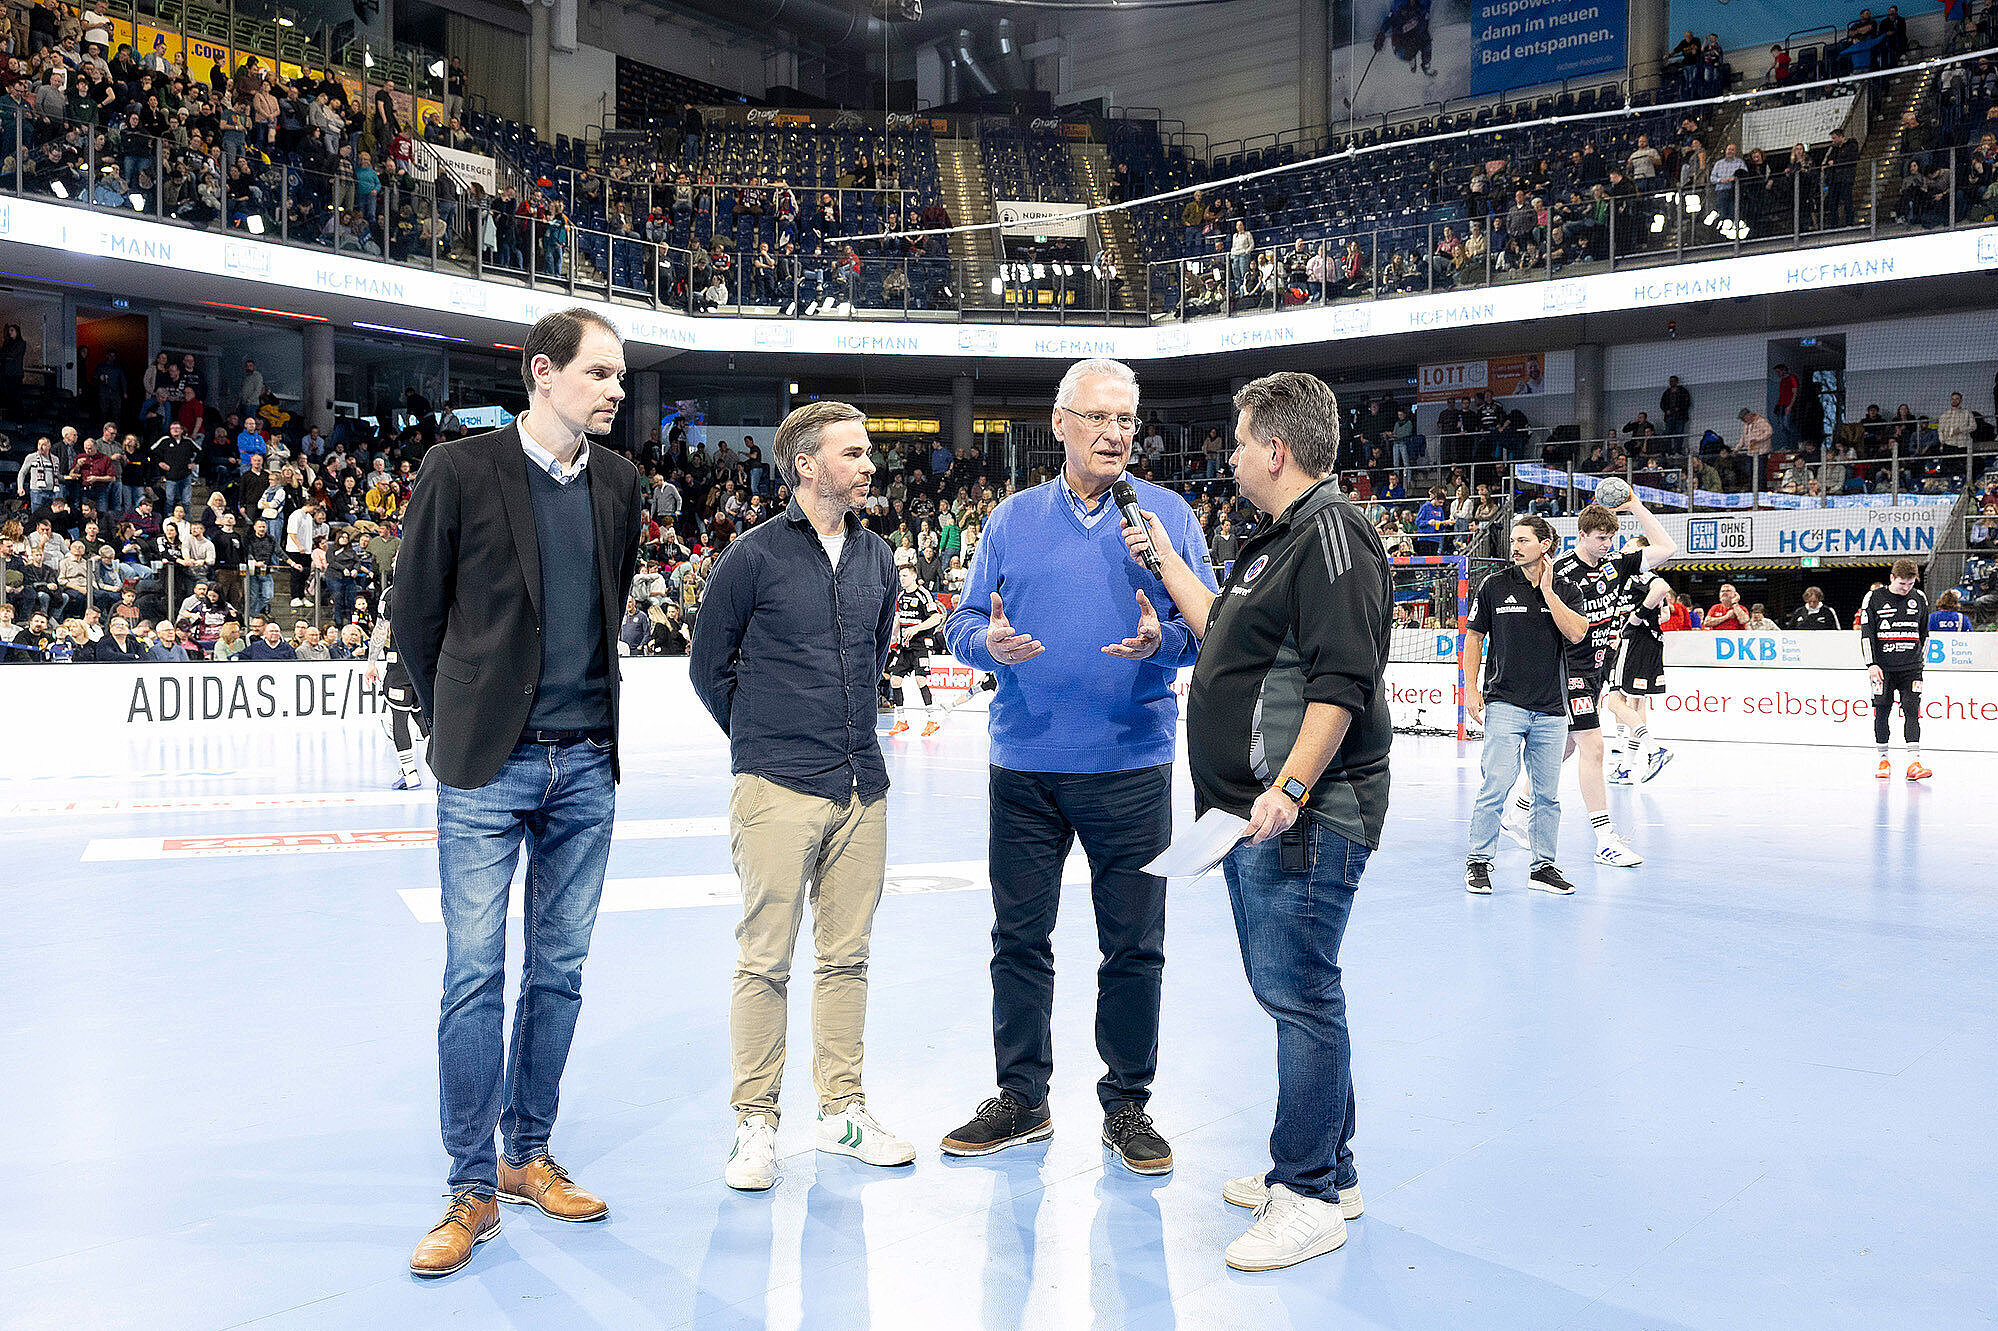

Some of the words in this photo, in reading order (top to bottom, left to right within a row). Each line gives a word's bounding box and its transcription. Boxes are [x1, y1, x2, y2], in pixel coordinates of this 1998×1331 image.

[1482, 24, 1521, 42] dann
[1525, 17, 1544, 33] im
[1549, 6, 1599, 28] neuen
[1482, 45, 1511, 65] Bad
[1514, 28, 1614, 58] entspannen.
[1787, 257, 1896, 284] HOFMANN
[316, 269, 404, 298] HOFMANN
[1634, 275, 1732, 301] HOFMANN
[1410, 303, 1495, 326] HOFMANN
[631, 322, 696, 344] HOFMANN
[837, 335, 919, 350] HOFMANN
[1220, 327, 1295, 348] HOFMANN
[1035, 341, 1116, 354] HOFMANN
[1868, 510, 1935, 523] Personal
[1692, 522, 1716, 534] KEIN
[1721, 522, 1745, 534] OHNE
[1692, 536, 1716, 550] FAN
[1721, 536, 1748, 548] JOB.
[1779, 526, 1934, 553] HOFMANN
[1716, 637, 1777, 661] DKB
[1782, 637, 1797, 645] Das
[1951, 639, 1968, 647] Das
[127, 669, 387, 723] ADIDAS.DE/H
[1665, 690, 1732, 713] oder
[1743, 691, 1998, 723] selbstgechte
